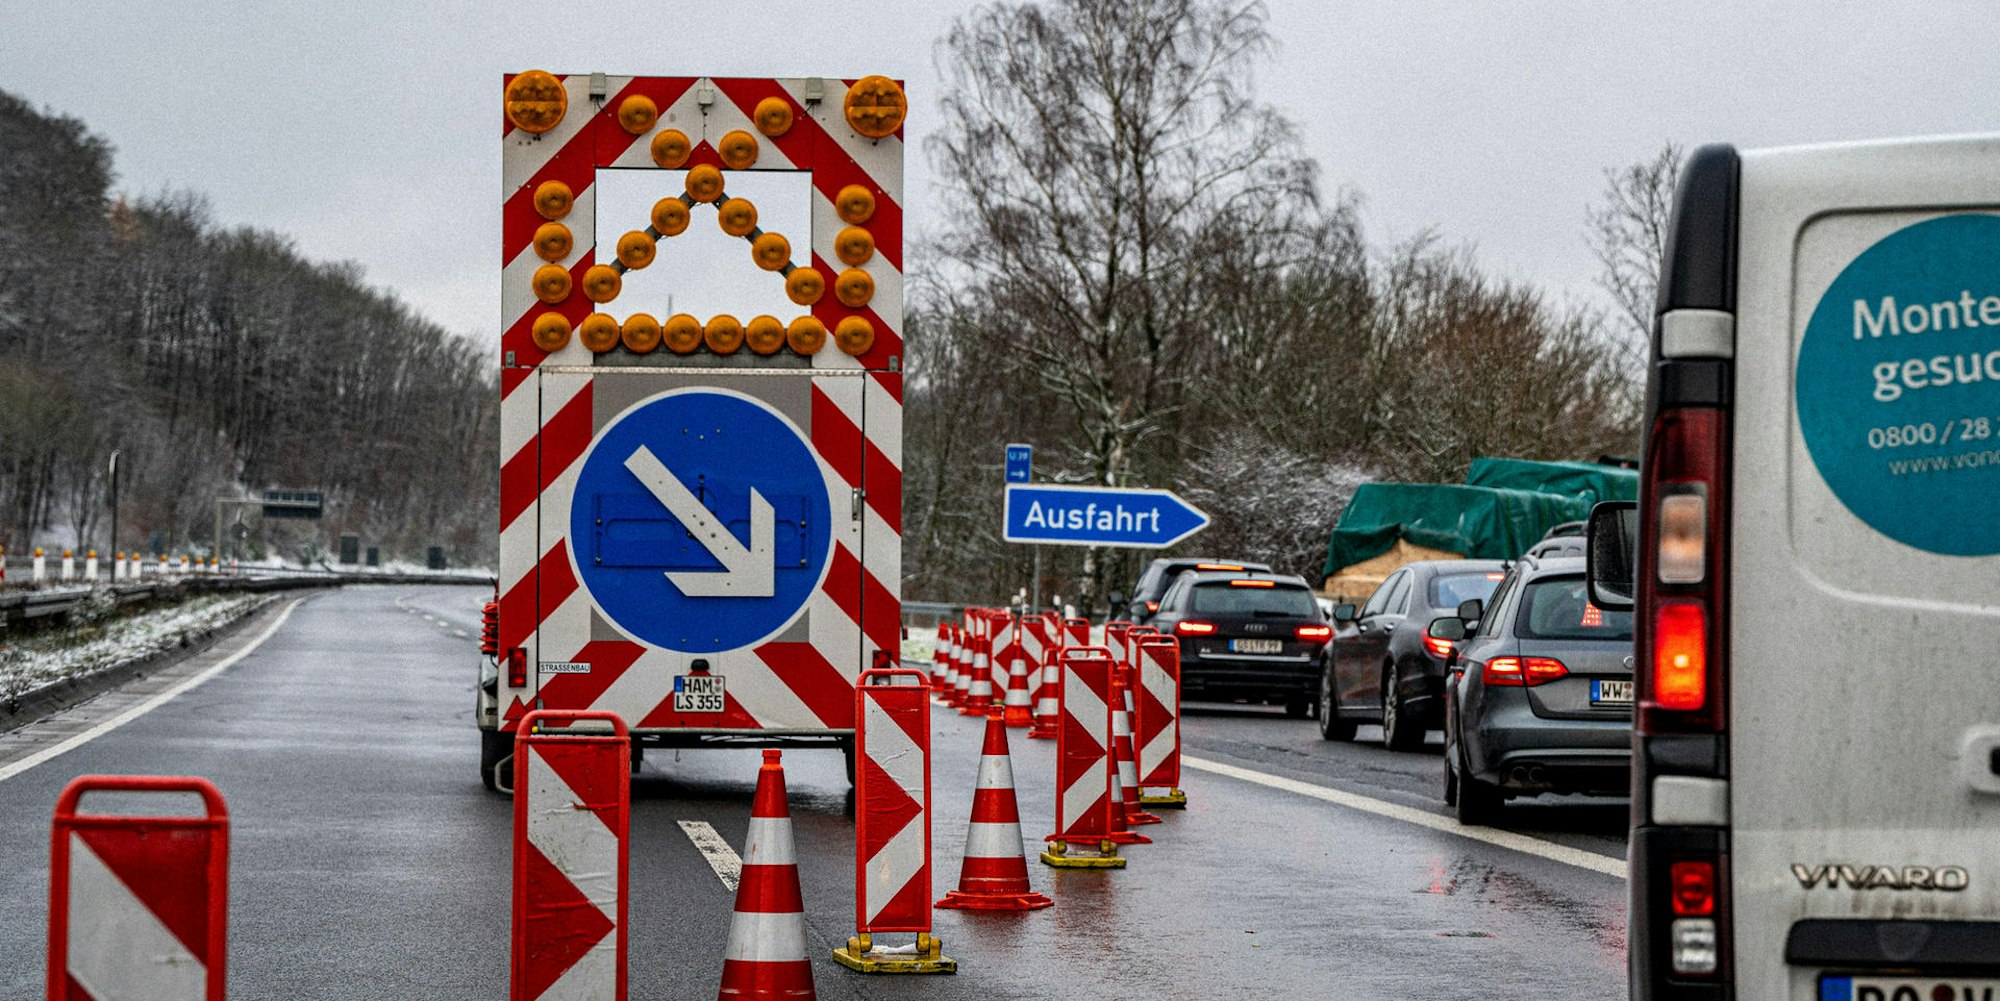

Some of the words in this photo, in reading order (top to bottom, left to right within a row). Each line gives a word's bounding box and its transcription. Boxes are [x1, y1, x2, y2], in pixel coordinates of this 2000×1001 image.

[1853, 290, 2000, 340] Monte
[1868, 422, 1937, 449] 0800
[1960, 416, 1991, 441] 28
[1024, 500, 1160, 533] Ausfahrt
[540, 663, 592, 673] STRASSENBAU
[682, 678, 713, 693] HAM
[1601, 683, 1623, 699] WW
[676, 695, 694, 710] LS
[696, 695, 723, 710] 355
[1791, 863, 1970, 892] VIVARO
